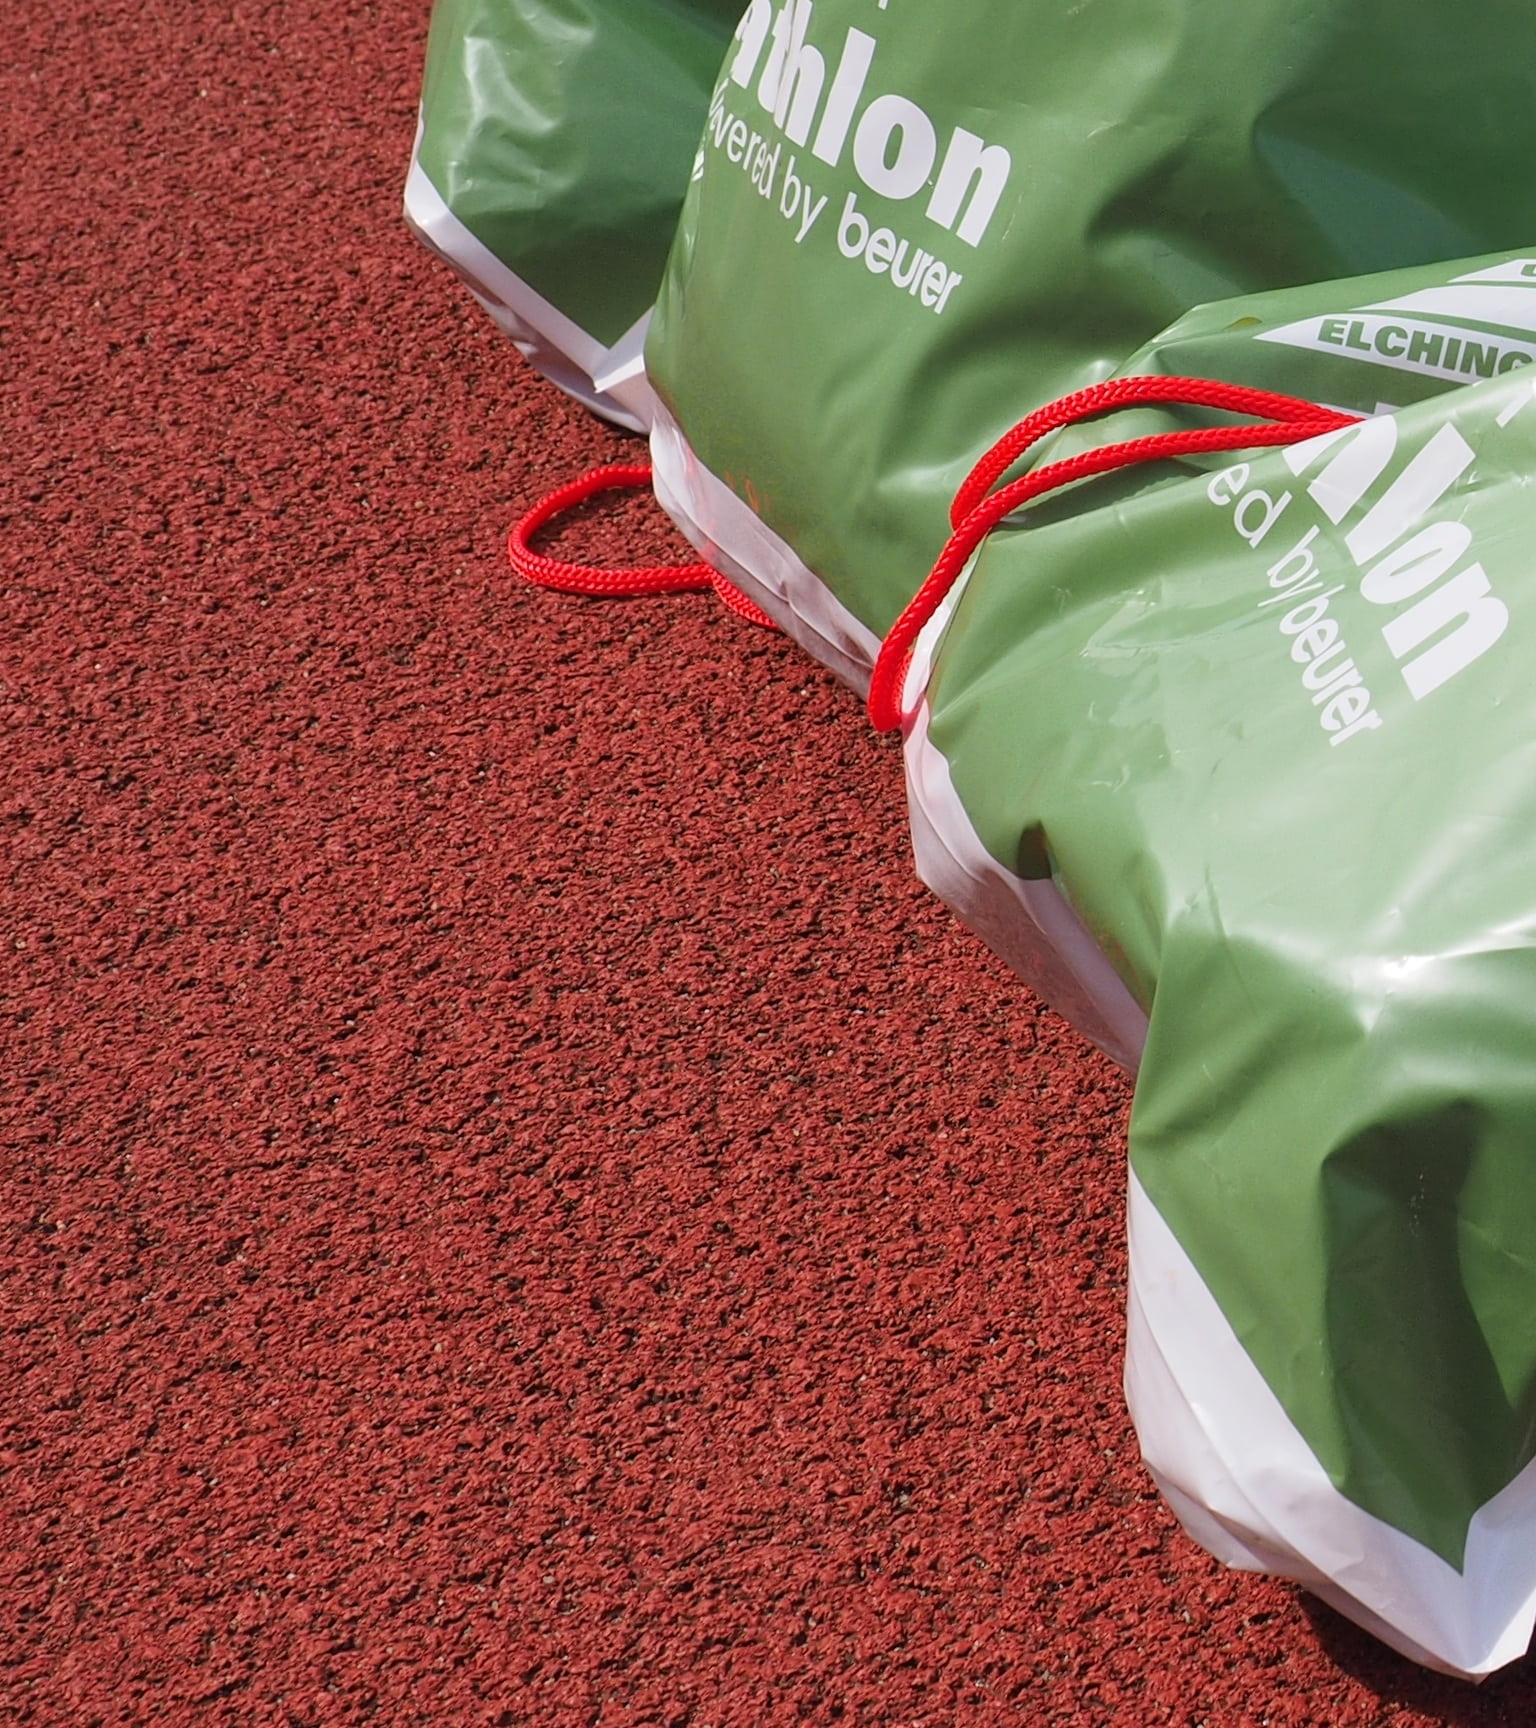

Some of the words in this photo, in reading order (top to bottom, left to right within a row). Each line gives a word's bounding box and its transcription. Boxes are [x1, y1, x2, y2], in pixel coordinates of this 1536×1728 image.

[779, 154, 829, 245] by
[836, 190, 963, 316] beurer
[1278, 583, 1385, 748] beurer
